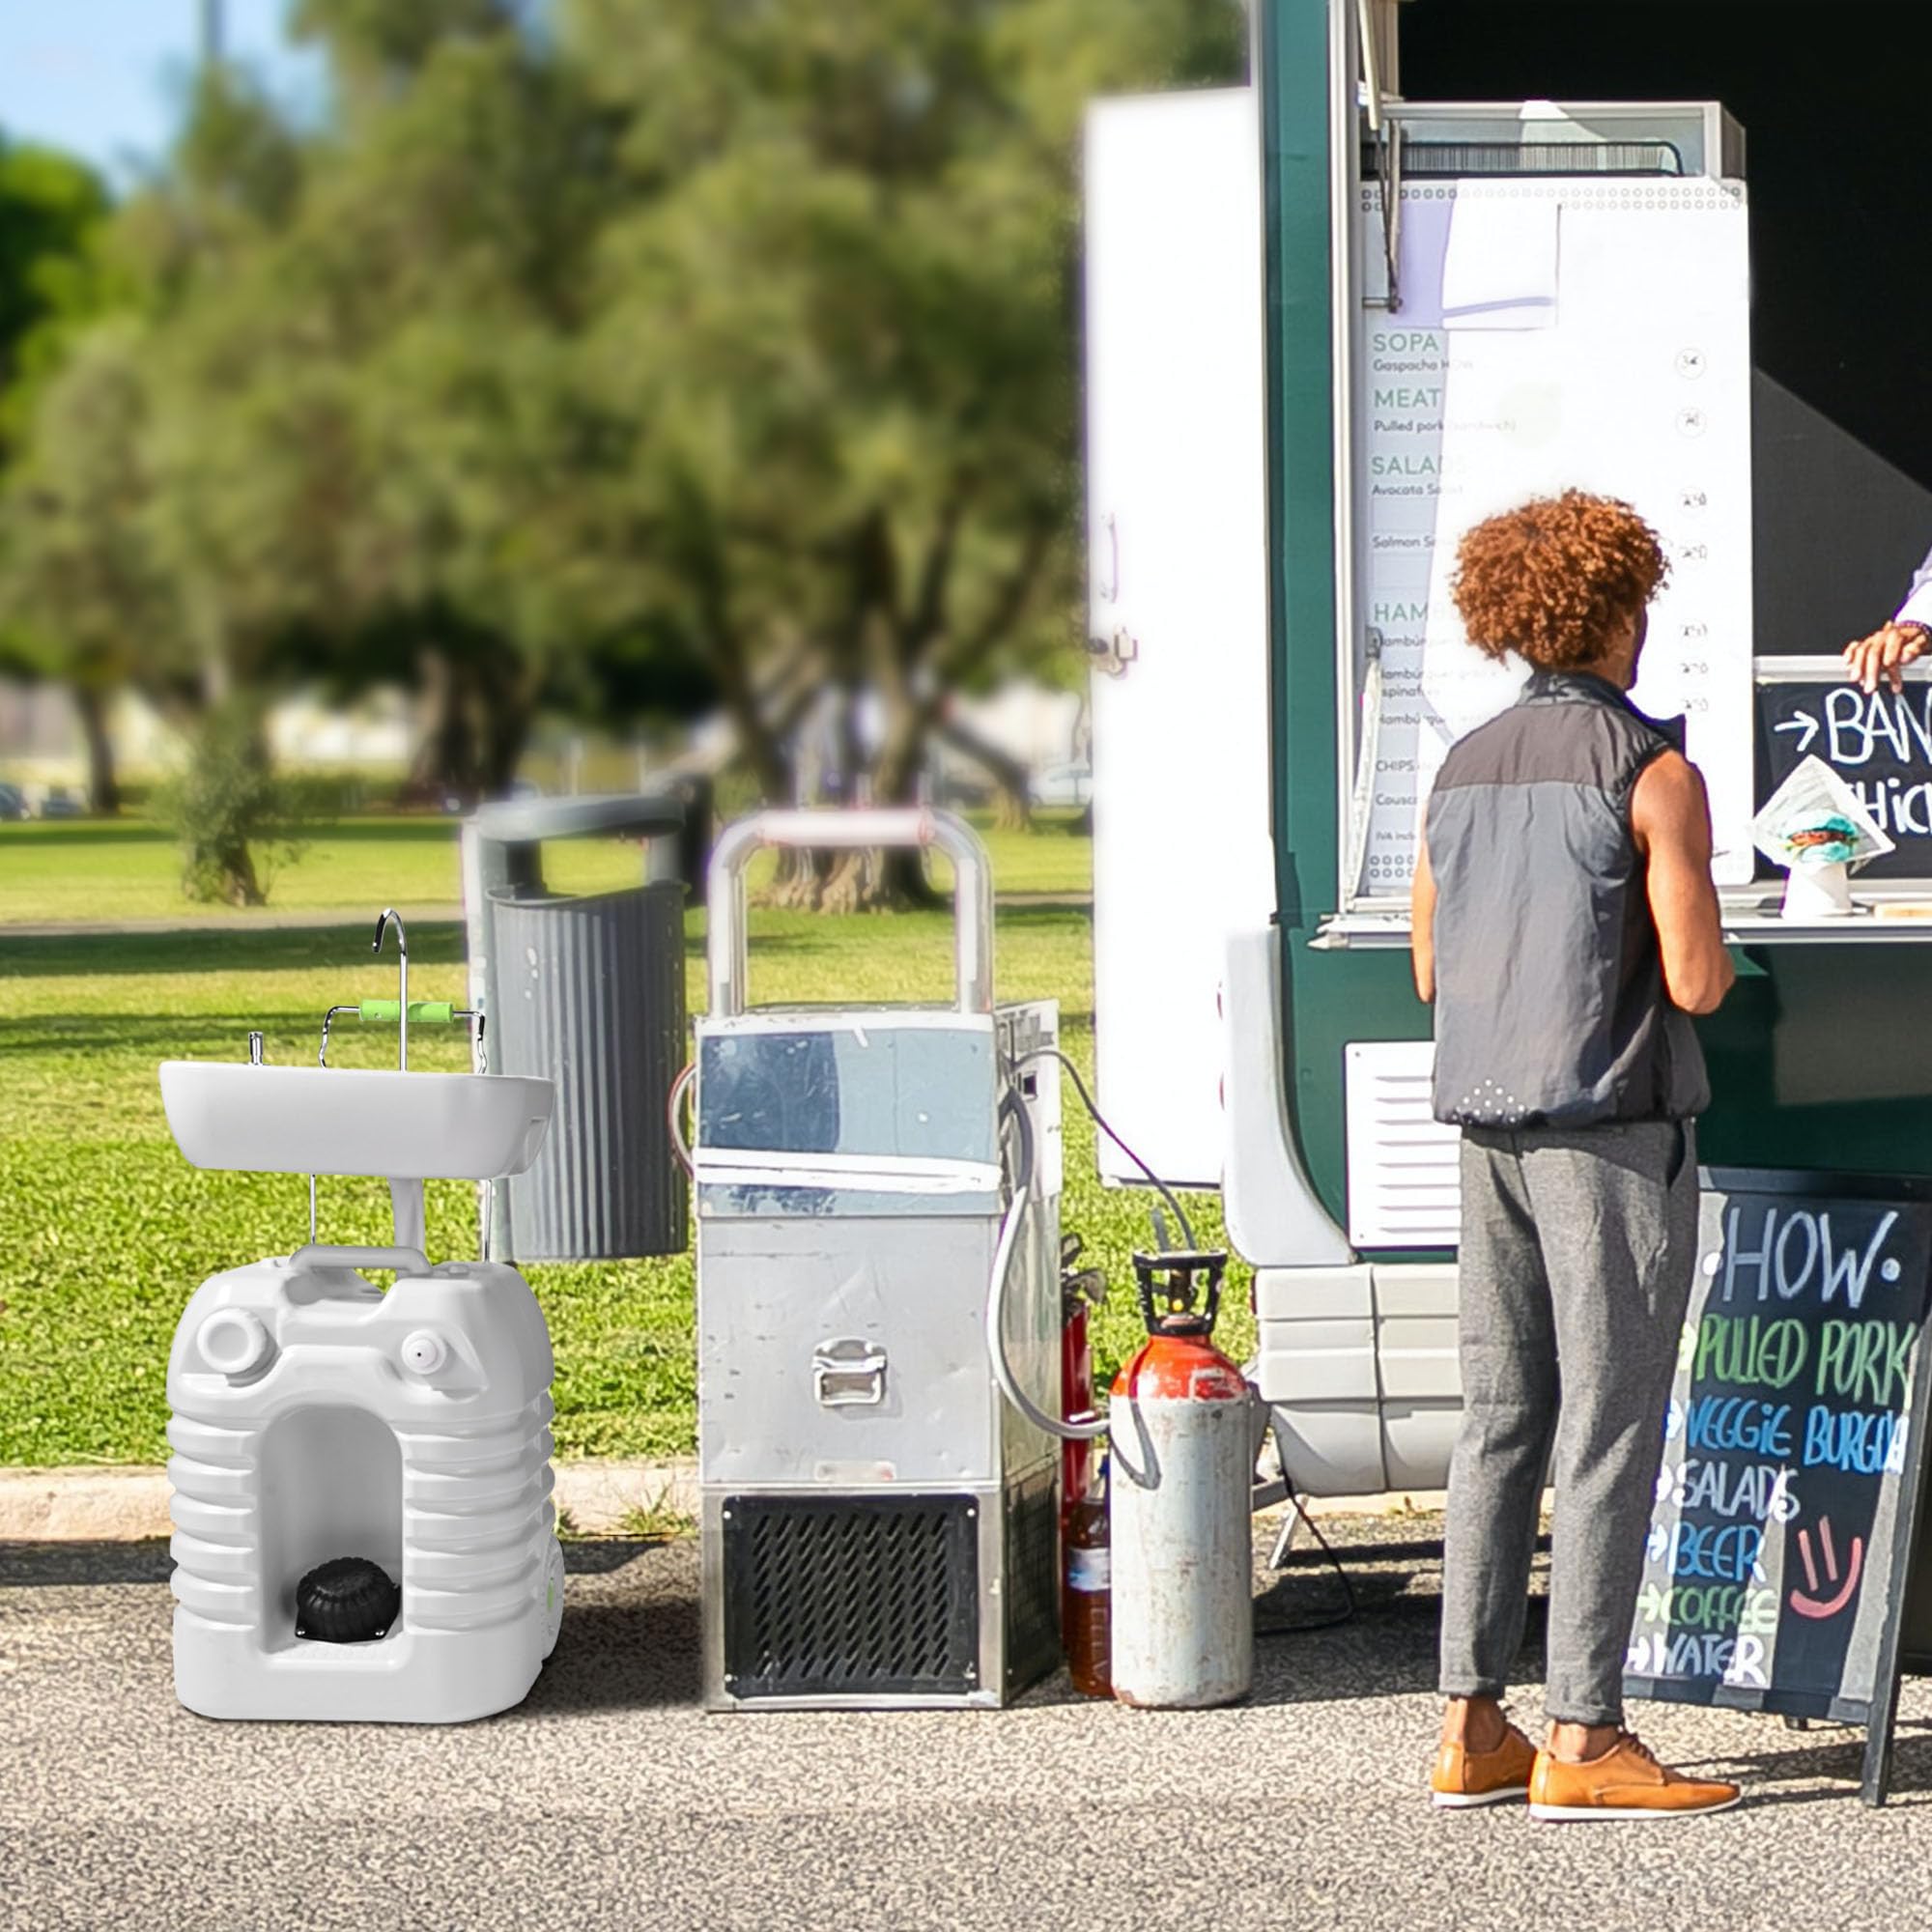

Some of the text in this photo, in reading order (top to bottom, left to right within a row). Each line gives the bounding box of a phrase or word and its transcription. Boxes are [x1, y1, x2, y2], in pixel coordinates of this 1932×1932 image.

[1373, 333, 1439, 353] SOPA
[1375, 388, 1442, 408] MEAT
[1374, 419, 1413, 432] Pulled
[1372, 535, 1421, 549] Salmon
[1696, 1313, 1917, 1409] PULLED PORK
[1672, 1459, 1801, 1523] SALADS
[1667, 1520, 1767, 1582] BEER
[1661, 1585, 1777, 1634] COFFEE
[1653, 1633, 1767, 1686] WATER
